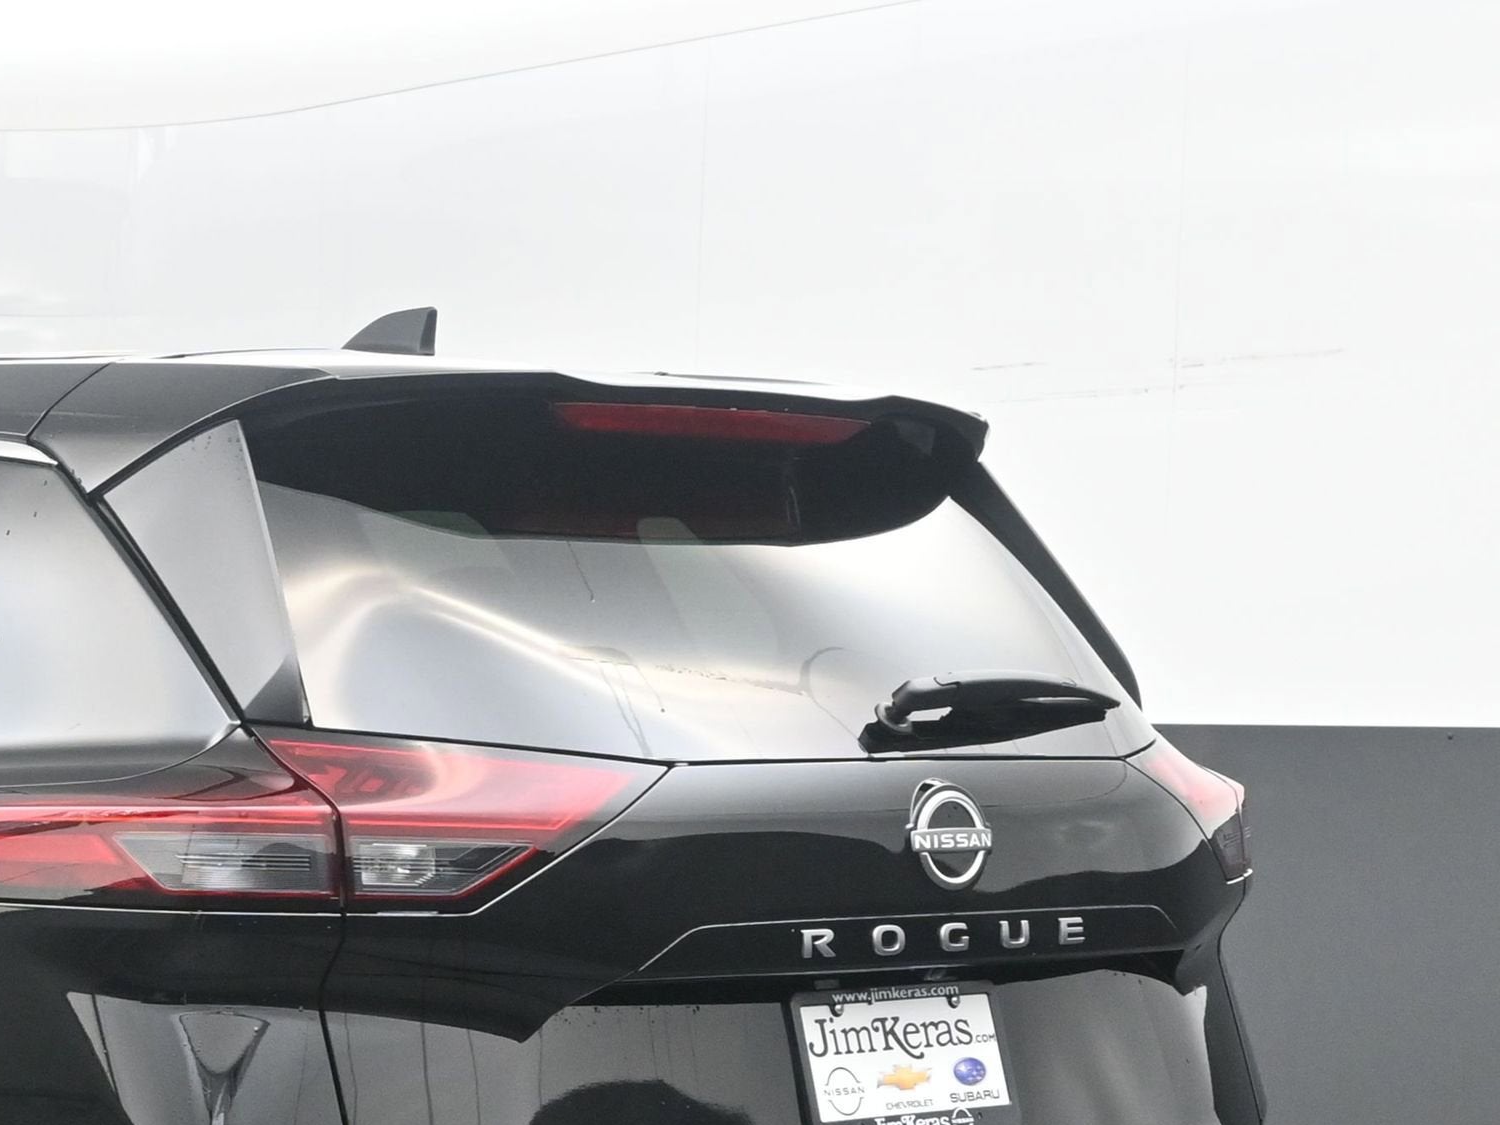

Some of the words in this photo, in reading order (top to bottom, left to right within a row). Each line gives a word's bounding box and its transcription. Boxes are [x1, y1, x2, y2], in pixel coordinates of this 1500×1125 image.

[914, 831, 992, 849] NISSAN
[800, 916, 1087, 959] ROGUE
[832, 985, 959, 1004] www.jimkeras.com
[823, 1086, 865, 1096] NISSAN
[949, 1089, 1000, 1103] SUBARU
[885, 1098, 934, 1111] CHEVROLET
